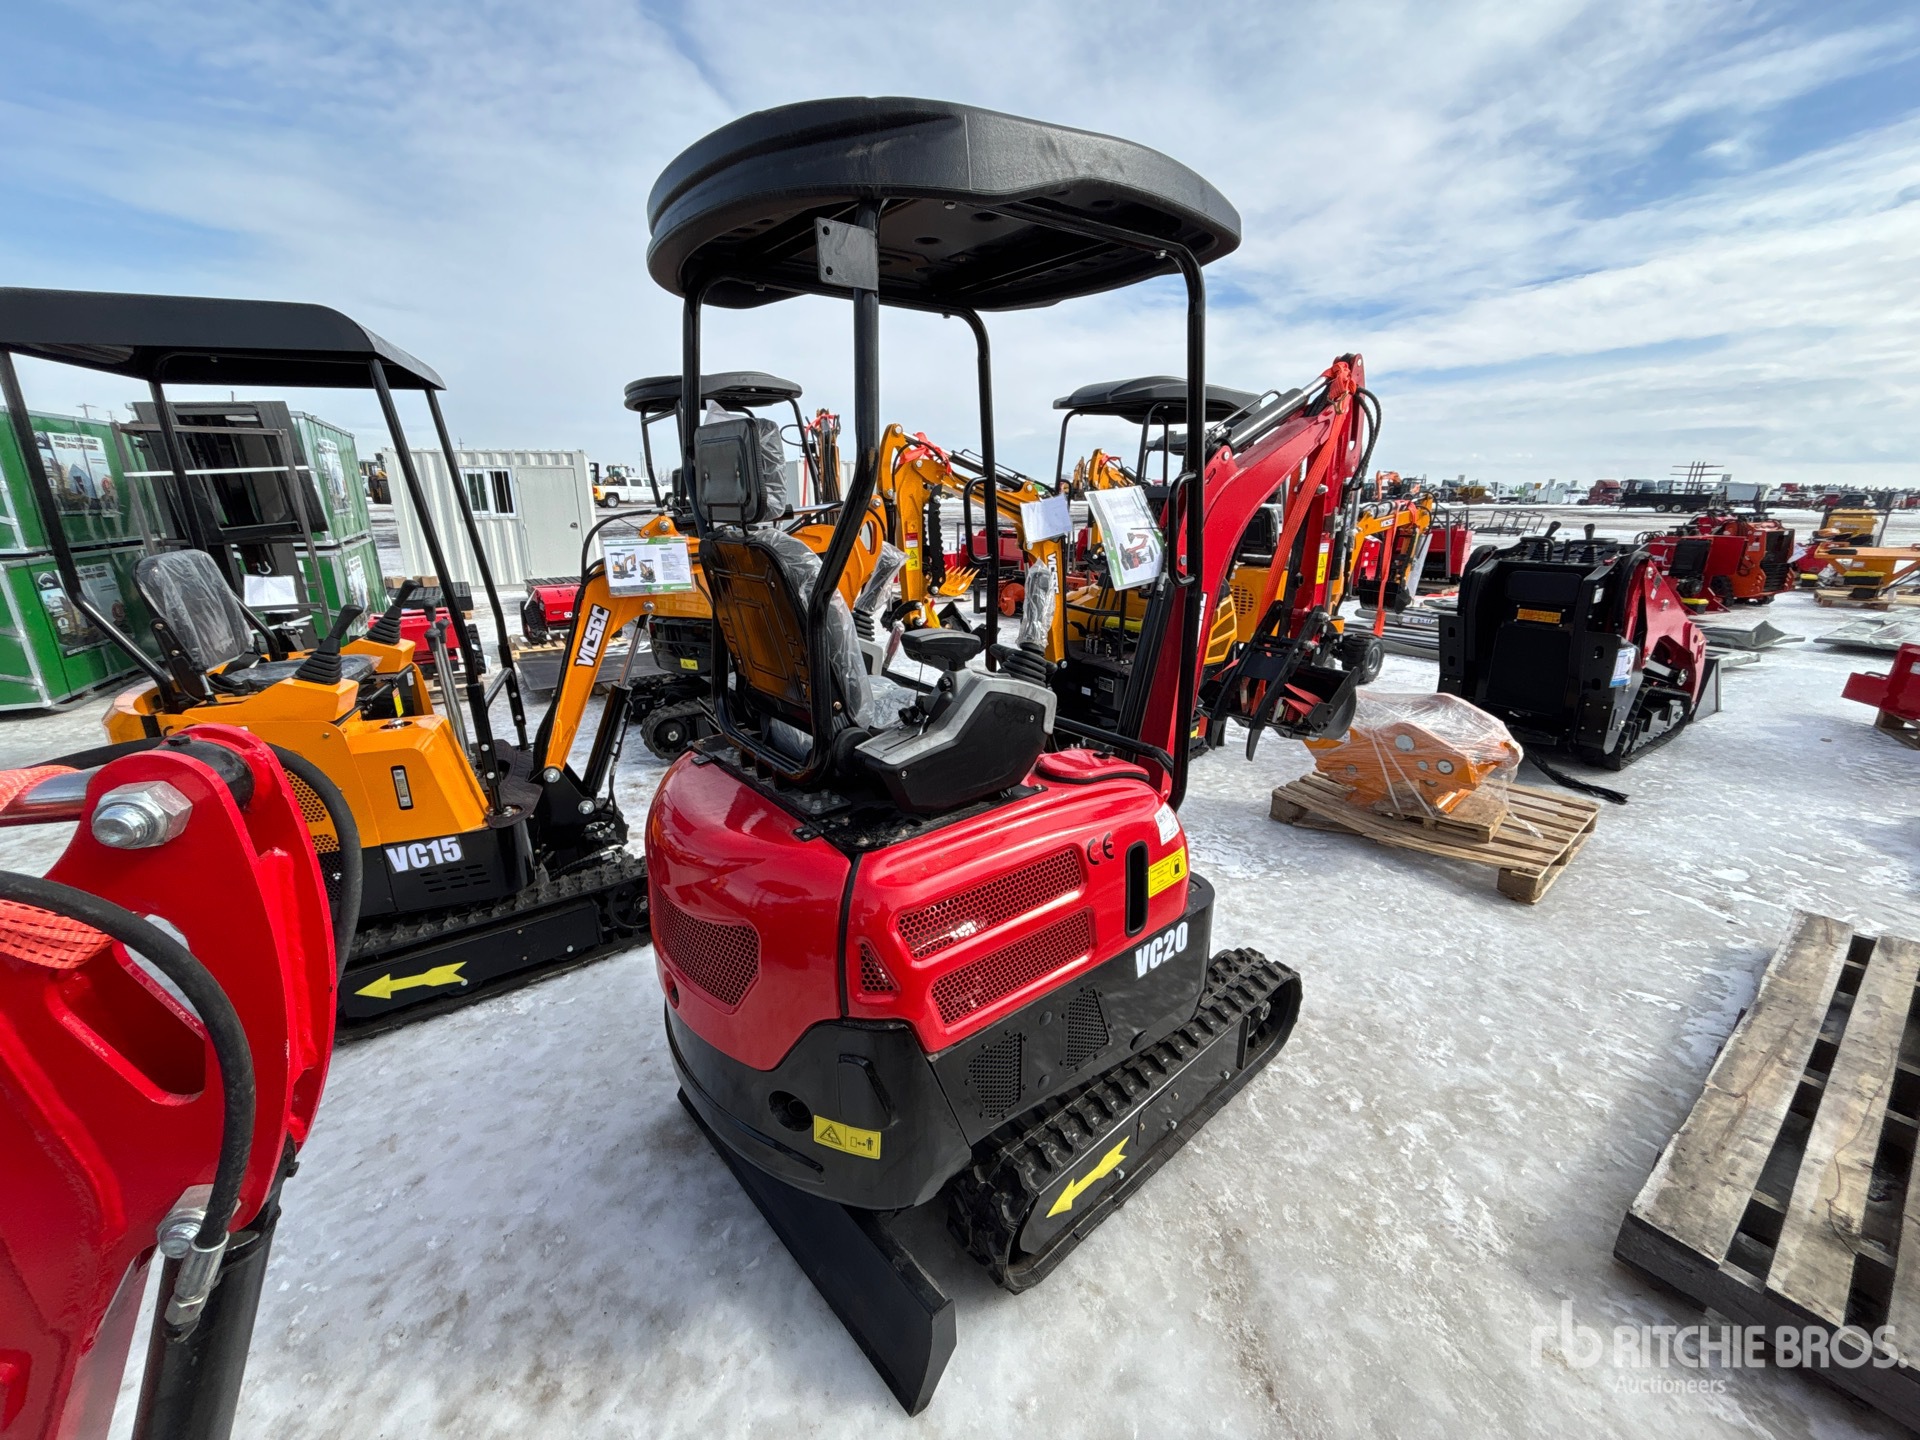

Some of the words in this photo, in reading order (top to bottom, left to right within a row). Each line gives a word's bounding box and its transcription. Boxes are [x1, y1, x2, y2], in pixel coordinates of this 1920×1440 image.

[575, 603, 611, 667] VICSEC
[385, 836, 463, 873] VC15
[1086, 832, 1115, 866] CE
[1135, 921, 1189, 978] VC20
